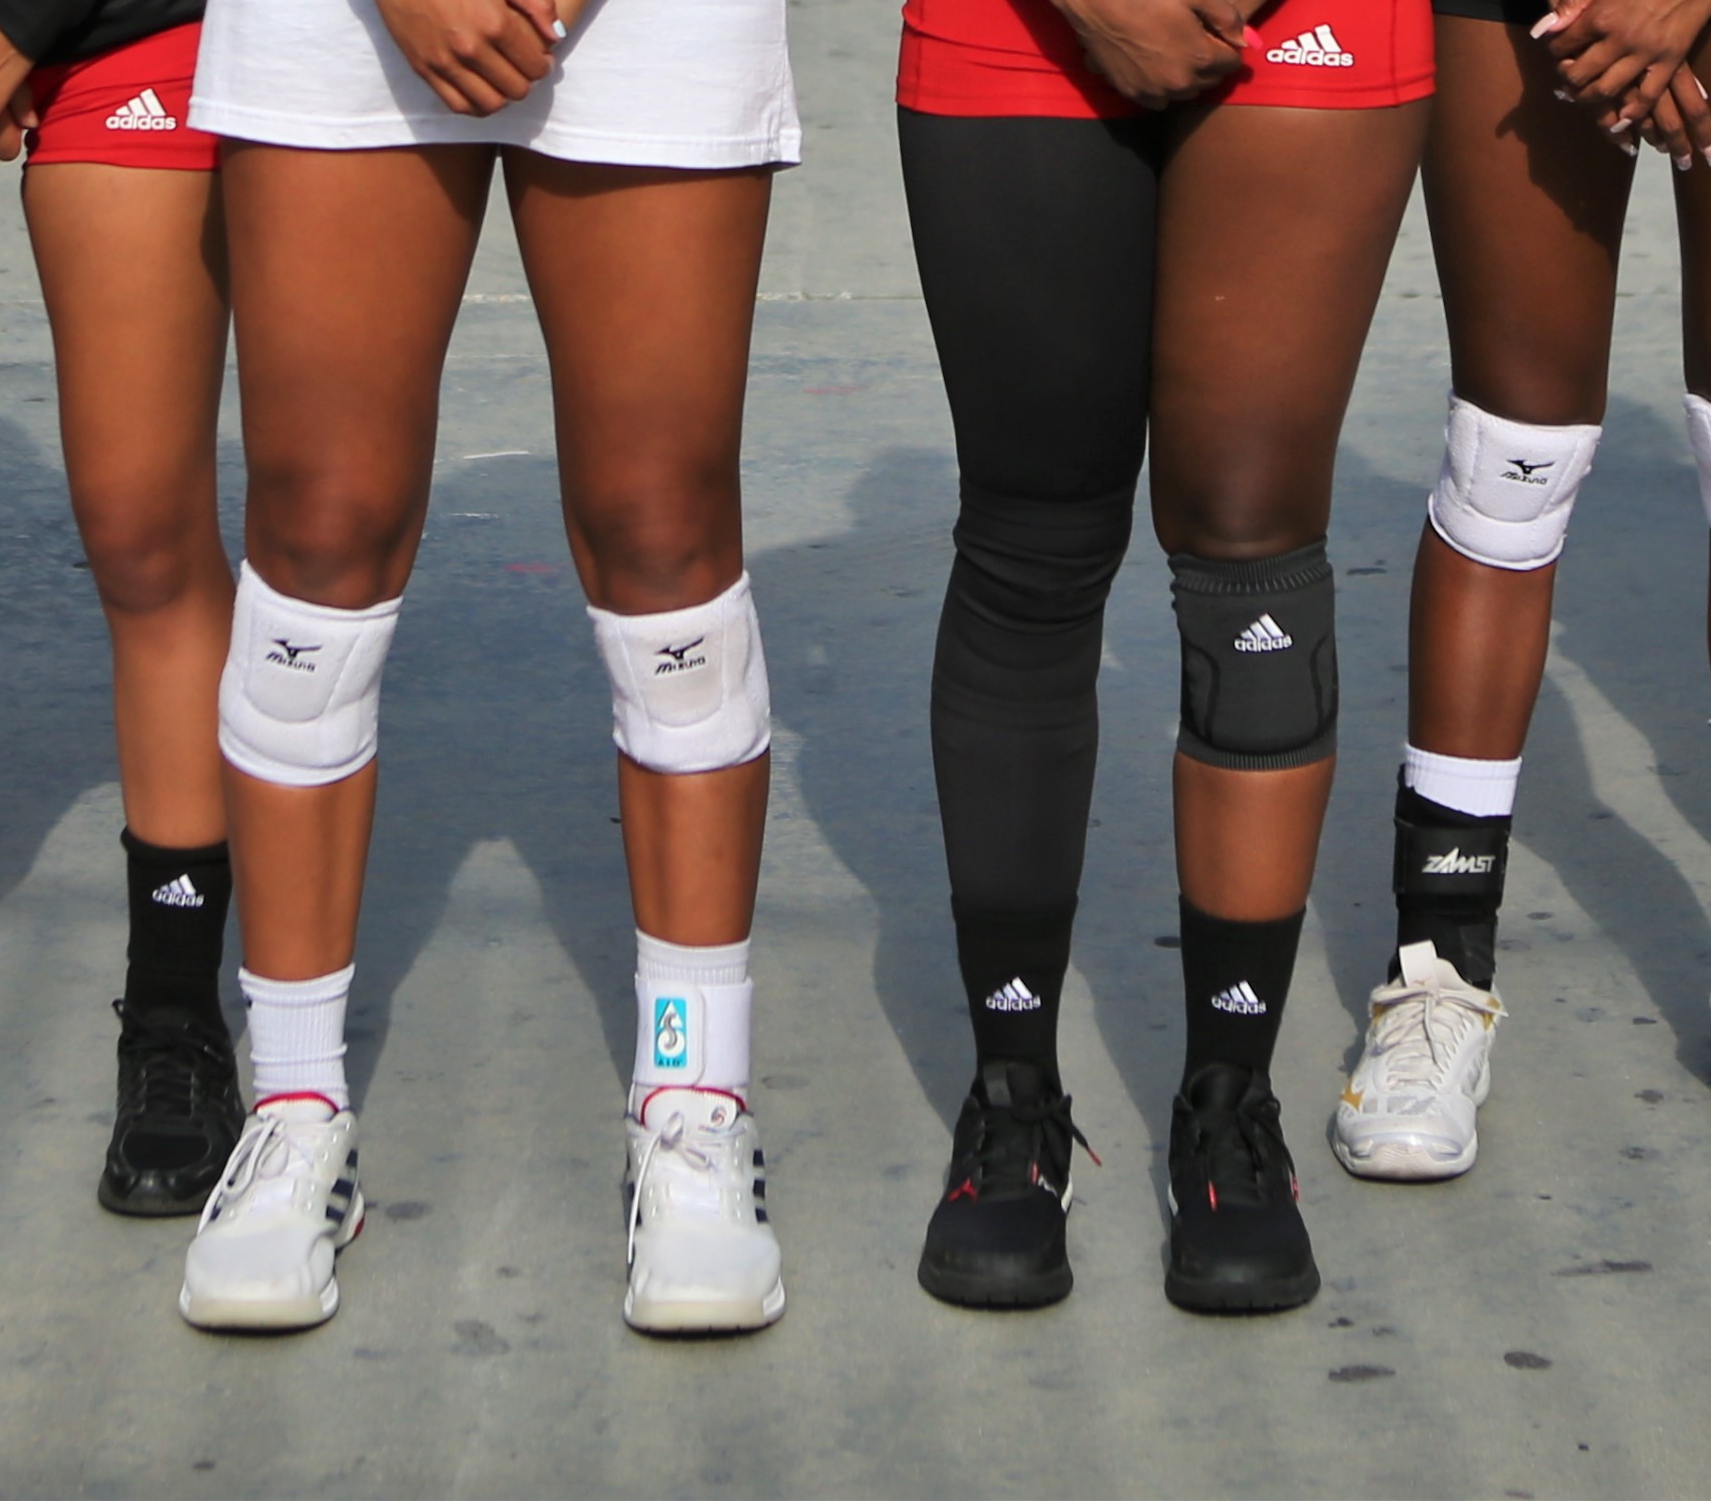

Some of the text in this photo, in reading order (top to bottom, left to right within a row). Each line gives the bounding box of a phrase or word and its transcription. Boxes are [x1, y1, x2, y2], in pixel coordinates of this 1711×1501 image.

[1266, 47, 1354, 67] adidas
[105, 115, 177, 130] adidas
[1234, 634, 1293, 652] adidas
[1422, 847, 1496, 874] ZAMST
[152, 889, 205, 907] adidas
[986, 996, 1041, 1012] adidas
[1211, 997, 1267, 1015] adidas
